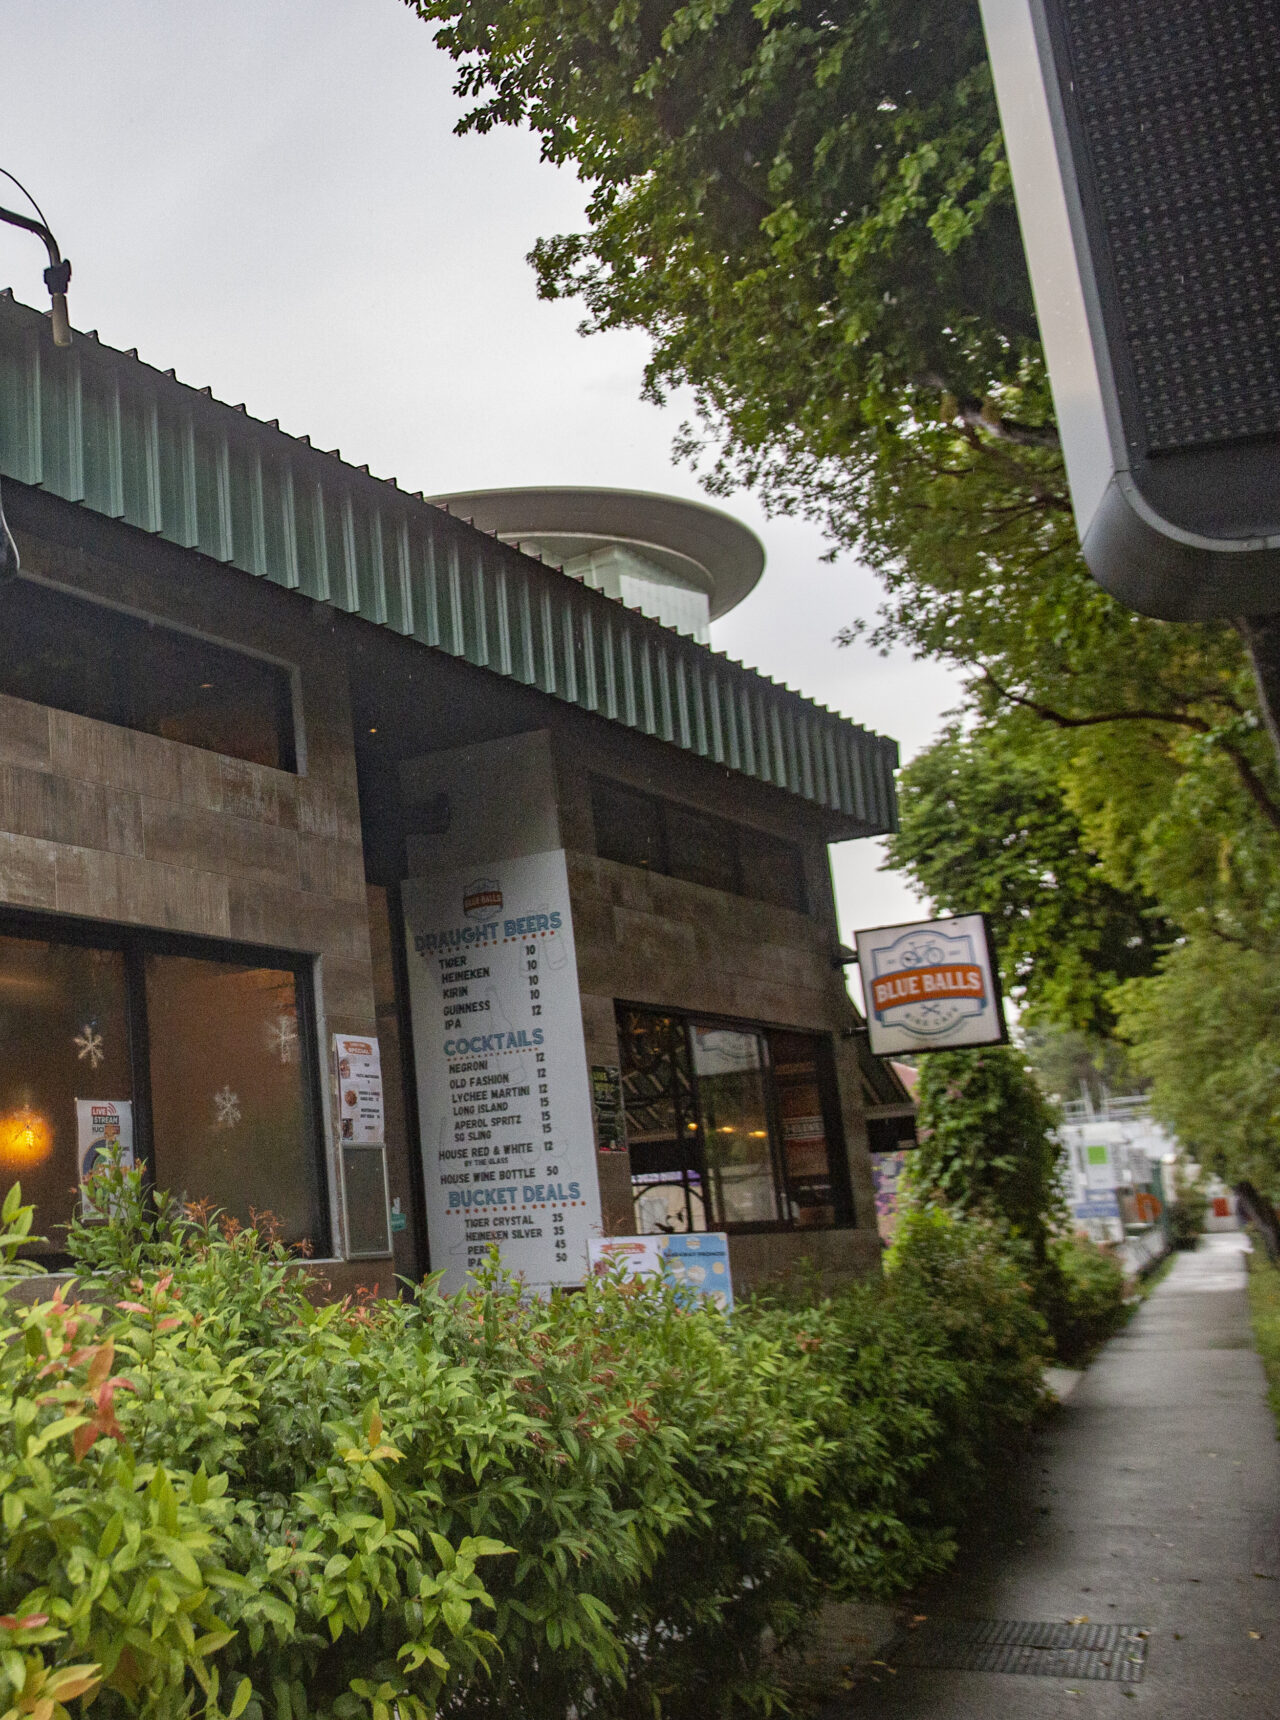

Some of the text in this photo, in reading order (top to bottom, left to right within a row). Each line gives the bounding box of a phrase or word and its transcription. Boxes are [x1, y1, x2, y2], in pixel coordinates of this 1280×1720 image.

[414, 912, 562, 951] DRAUGHT BEERS
[439, 945, 536, 970] TIGER 10
[442, 960, 537, 984] HEINEKEN 10
[443, 975, 539, 999] KIRIN 10
[875, 972, 981, 1003] BLUE BALLS
[443, 990, 540, 1016] GUINNESS 10
[445, 1005, 542, 1030] IPA 12
[443, 1028, 544, 1056] COCKTAILS
[449, 1052, 545, 1074] NEGRONI 12
[450, 1068, 546, 1089] OLD FASHION 12
[452, 1084, 548, 1103] LYCHEE MARTINI 12
[92, 1107, 106, 1116] LIVE
[453, 1097, 549, 1116] LONG ISLAND 15
[94, 1116, 118, 1124] STREAM
[454, 1111, 551, 1130] APEROL SPRITZ 15
[454, 1123, 552, 1142] SG SLING 15
[439, 1141, 554, 1160] HOUSE RED & WHITE 12
[488, 1157, 509, 1165] GLASS
[440, 1166, 559, 1185] HOUSE WINE BOTTLE 50
[448, 1182, 581, 1208] BUCKET DEALS
[464, 1213, 563, 1228] TIGER CRYSTAL 35
[466, 1226, 564, 1241] HEINEKEN SILVER 35
[555, 1239, 566, 1249] 45
[468, 1253, 567, 1267] IPA 50
